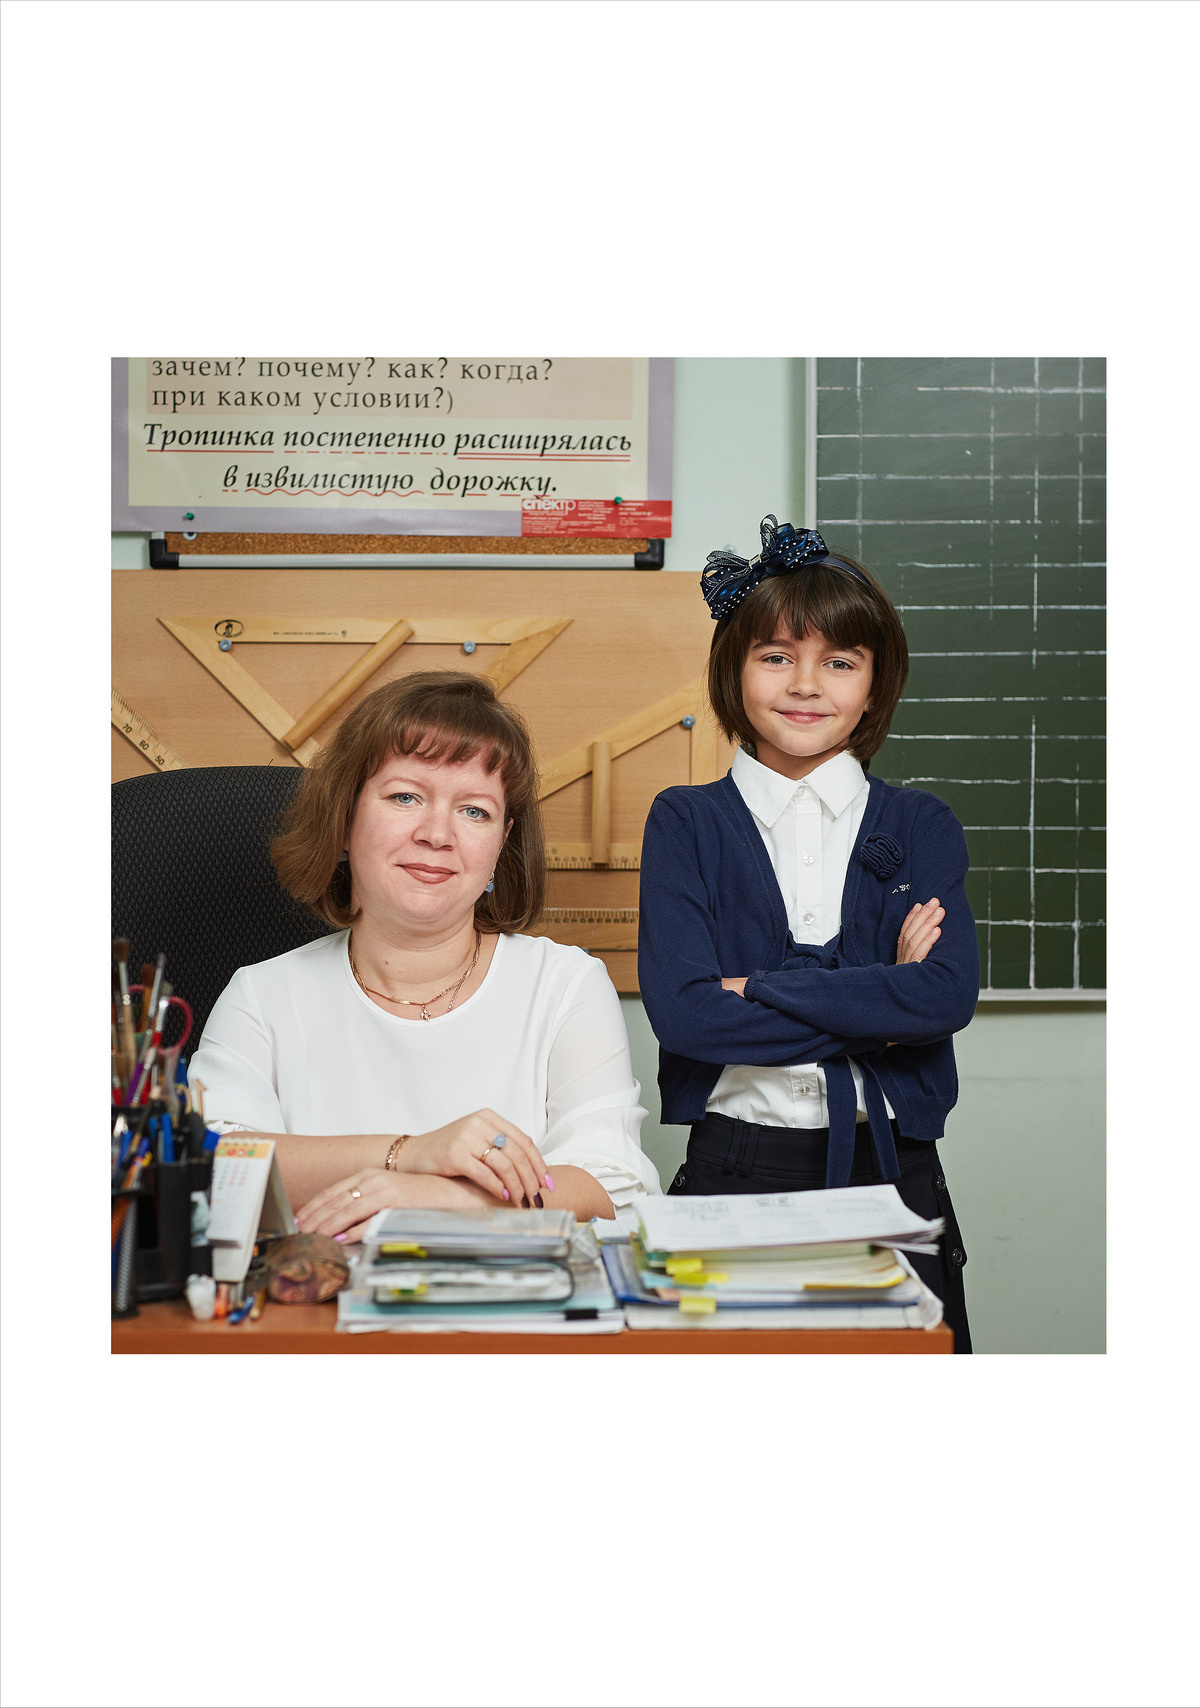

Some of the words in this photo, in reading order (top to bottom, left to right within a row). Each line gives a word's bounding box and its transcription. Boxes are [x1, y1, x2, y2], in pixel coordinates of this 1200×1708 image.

[152, 357, 246, 377] зачем?
[258, 357, 375, 385] почему?
[388, 357, 448, 380] как?
[461, 359, 553, 383] когда?
[152, 390, 206, 414] при
[217, 391, 300, 407] каком
[313, 387, 453, 415] условии?)
[144, 422, 274, 452] Тропинка
[283, 430, 446, 449] постепенно
[453, 432, 632, 457] расширялась
[223, 464, 239, 488] в
[246, 464, 414, 494] извилистую
[430, 468, 556, 500] дорожку.
[122, 723, 133, 734] 70
[139, 740, 150, 751] 60
[154, 755, 165, 766] 50
